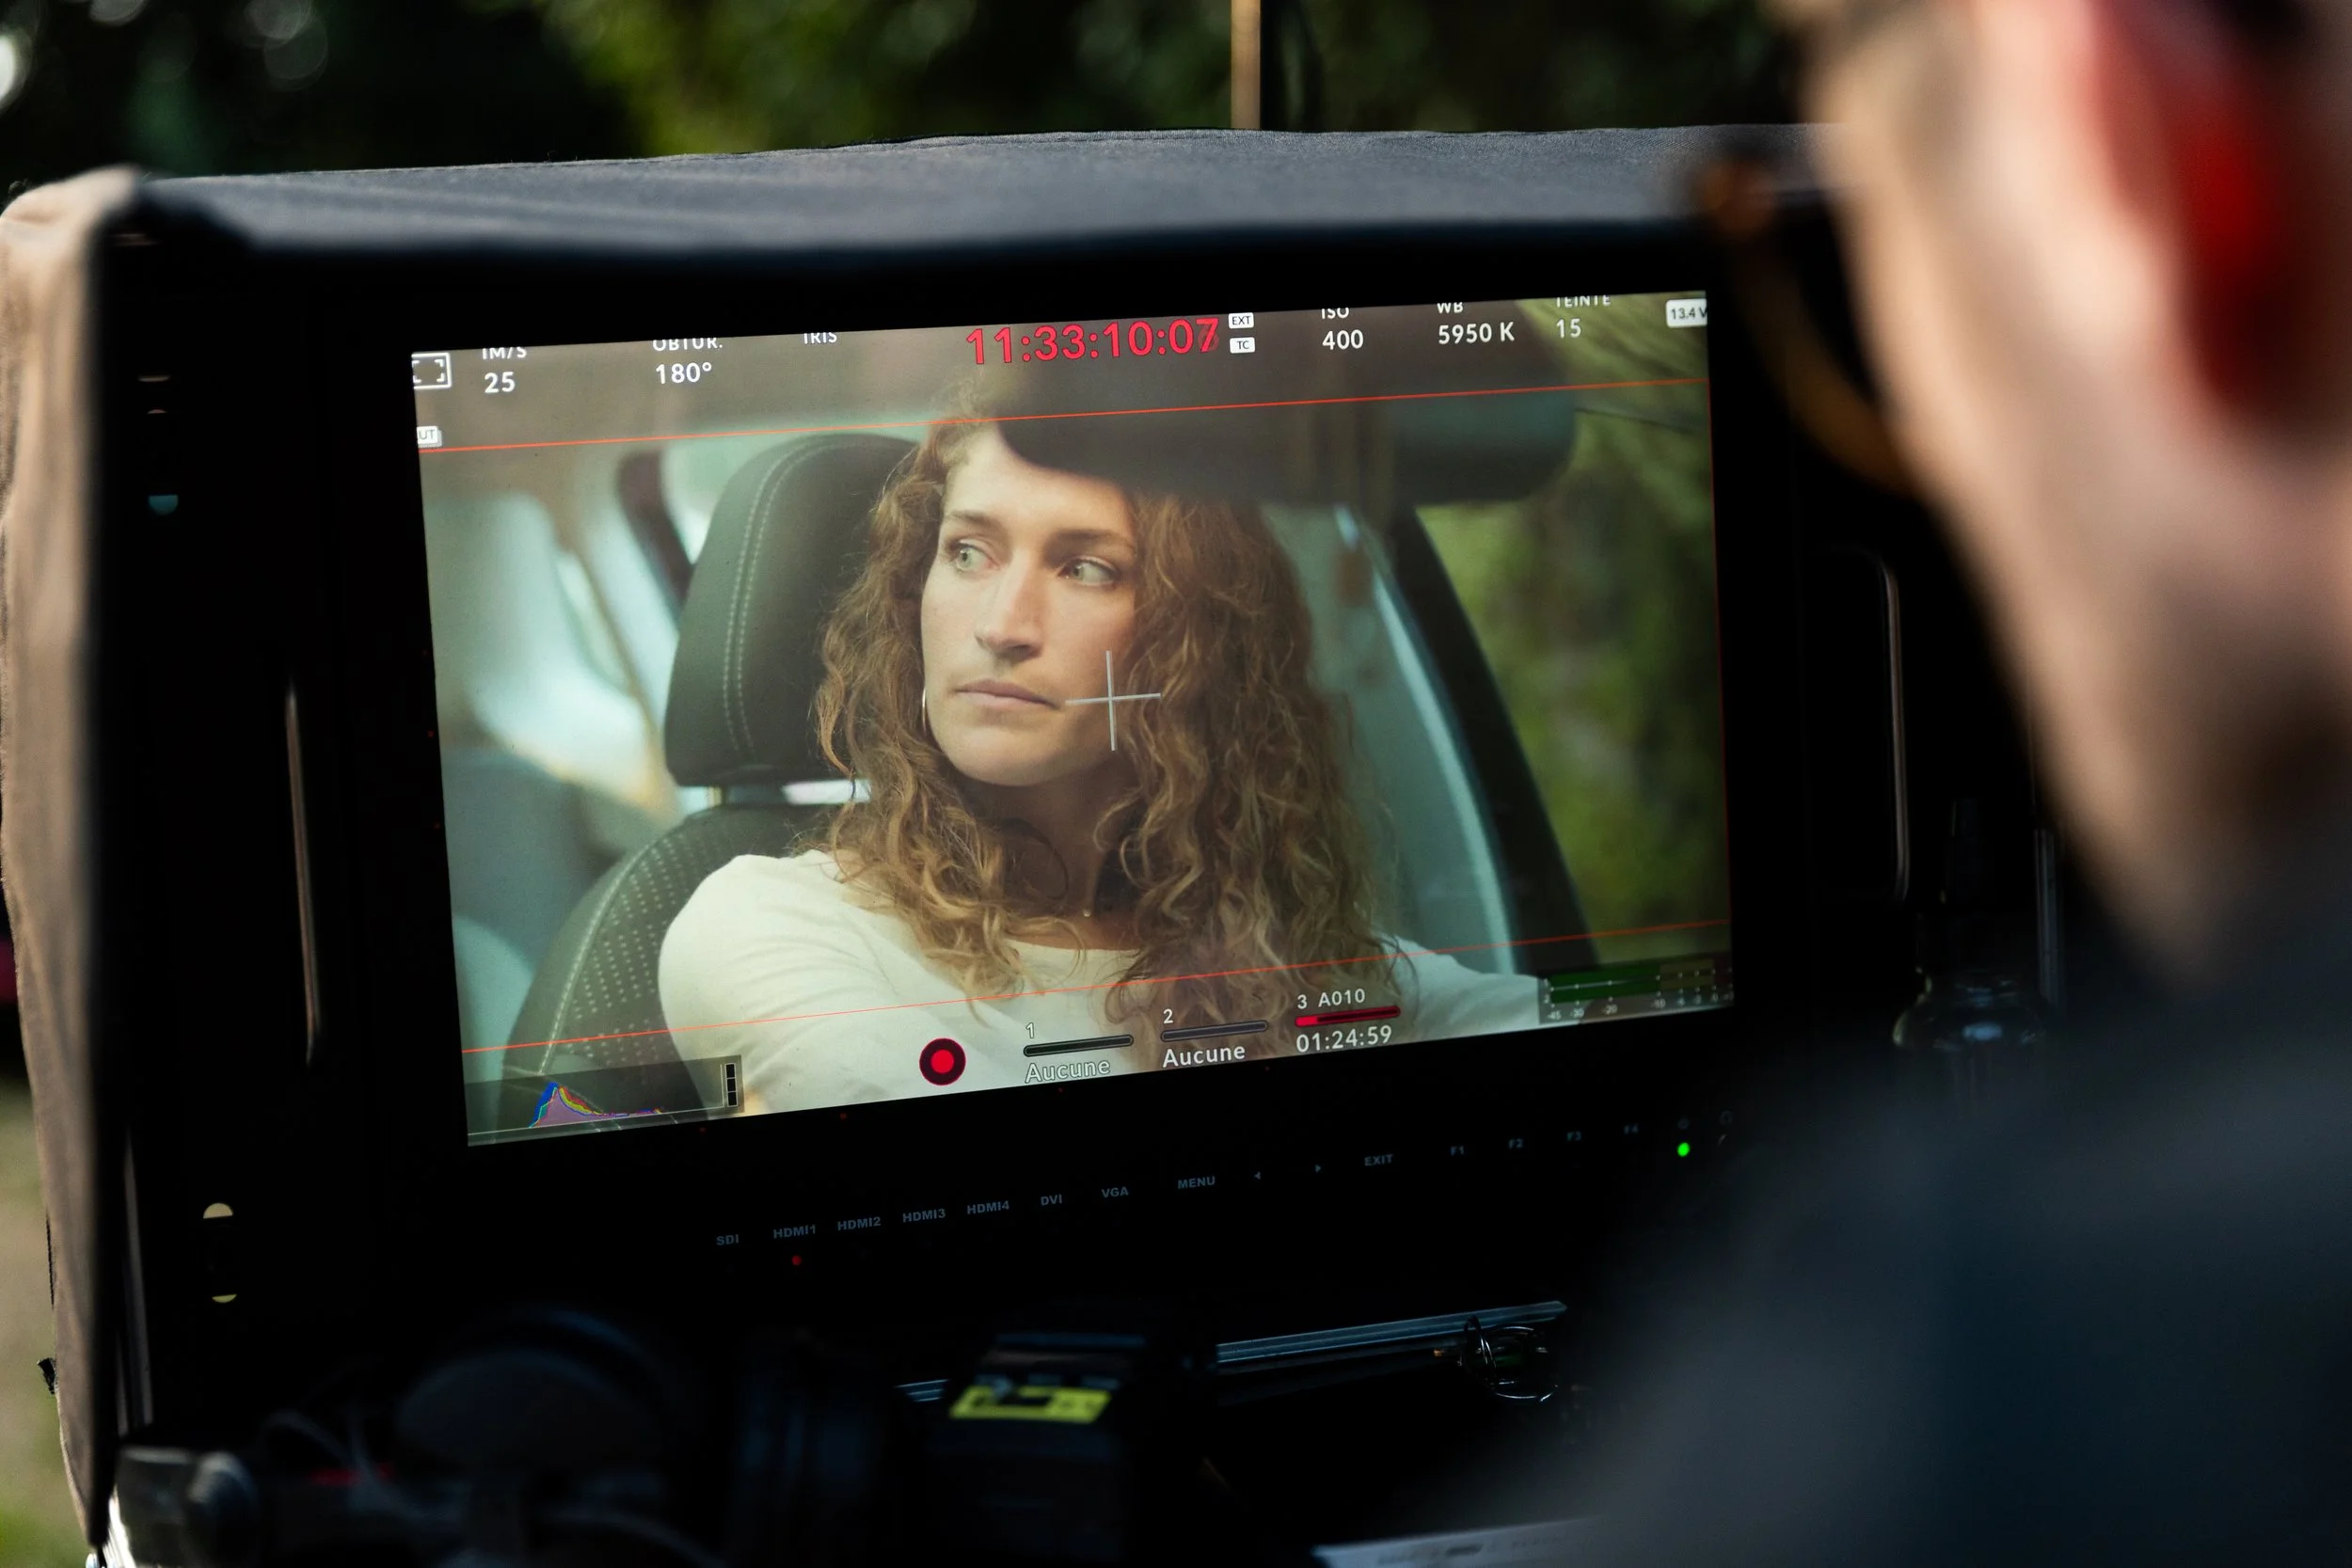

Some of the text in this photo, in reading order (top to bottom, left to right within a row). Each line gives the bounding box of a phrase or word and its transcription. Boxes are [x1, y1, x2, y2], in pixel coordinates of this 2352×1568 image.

[1321, 307, 1350, 320] ISO
[1437, 301, 1464, 314] WB
[1671, 307, 1696, 320] 13.4
[1232, 315, 1252, 325] EXT
[1438, 321, 1516, 345] 5950 K
[1556, 318, 1581, 339] 15
[652, 337, 723, 351] OBTUR.
[803, 331, 837, 344] IRIS
[966, 318, 1219, 365] 11:33:10:07
[1322, 328, 1364, 351] 400
[1236, 340, 1250, 350] TC
[483, 346, 527, 359] IM/S
[655, 361, 712, 385] 180°
[484, 372, 516, 393] 25
[1296, 988, 1366, 1009] 3 A010
[1163, 1008, 1174, 1025] 2
[1025, 1022, 1035, 1039] 1
[1295, 1024, 1392, 1053] 01:24:59
[1162, 1045, 1246, 1069] Aucune
[1025, 1059, 1111, 1084] Aucune
[1507, 1137, 1524, 1149] F2
[1565, 1130, 1582, 1143] F3
[1450, 1145, 1465, 1157] F1
[1364, 1154, 1393, 1167] EXIT
[1177, 1176, 1216, 1190] MENU
[1101, 1186, 1129, 1198] VGA
[966, 1200, 1010, 1215] HDMI4
[1040, 1194, 1063, 1207] DVI
[902, 1209, 946, 1223] HDMI3
[837, 1216, 882, 1231] HDMI2
[772, 1224, 817, 1240] HDMI1
[716, 1233, 740, 1246] SDI
